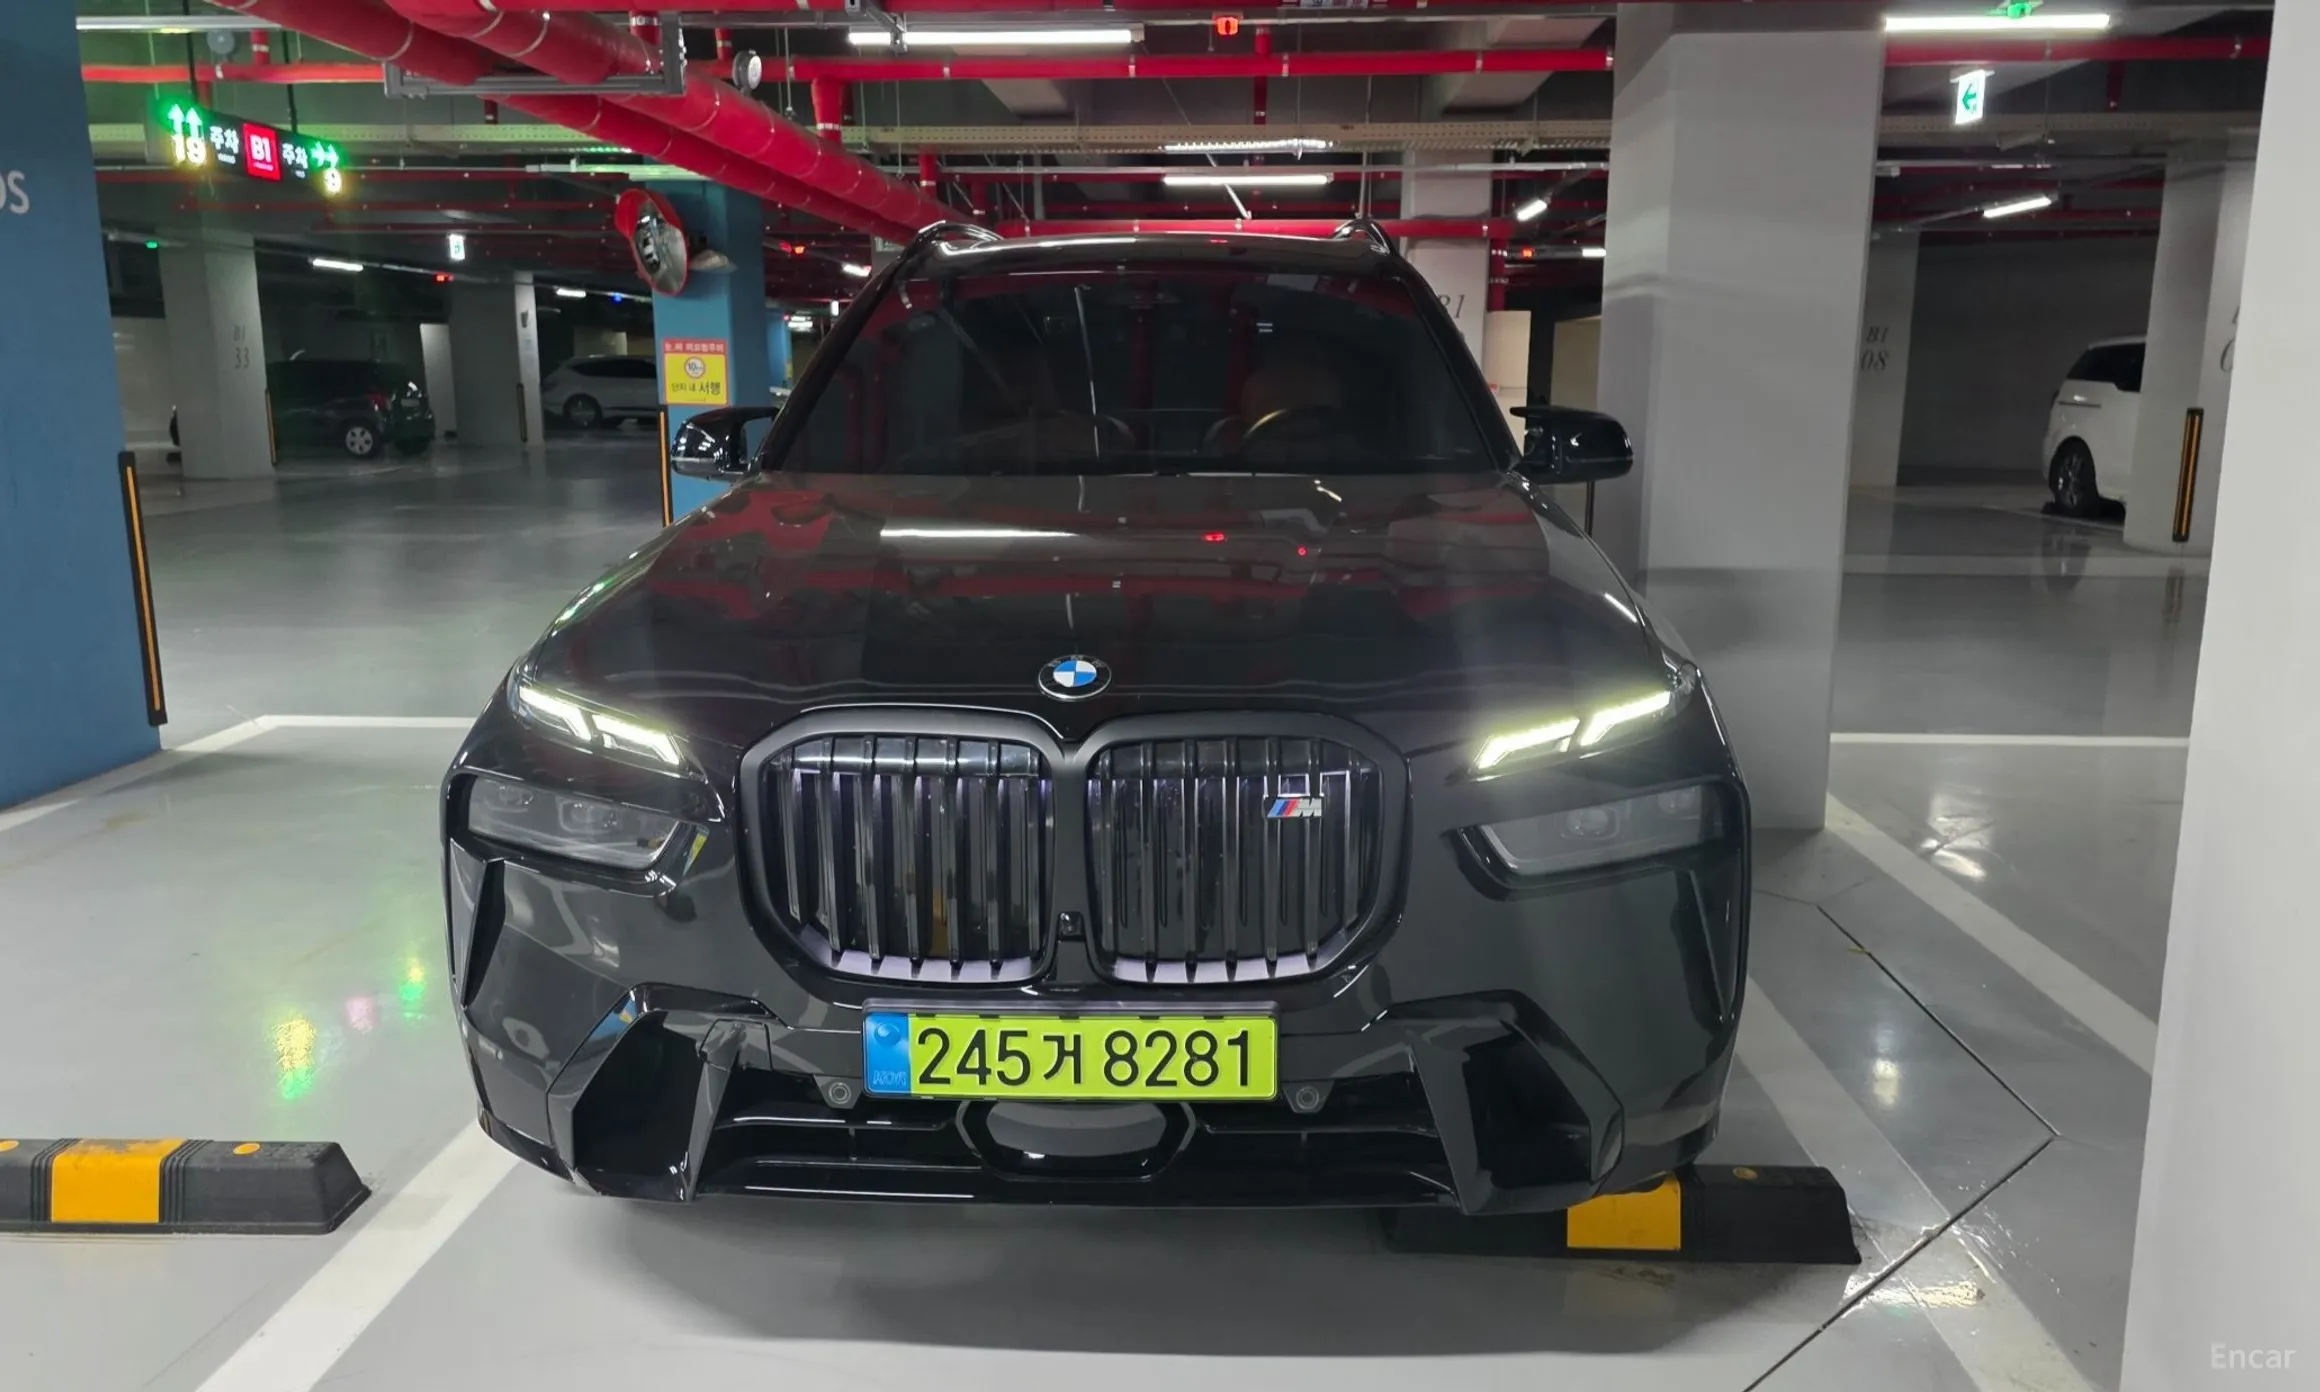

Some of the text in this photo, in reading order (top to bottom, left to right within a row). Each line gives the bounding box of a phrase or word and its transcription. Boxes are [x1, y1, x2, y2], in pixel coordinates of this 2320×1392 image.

[210, 126, 239, 154] 주차
[250, 135, 272, 162] B1
[282, 143, 308, 169] 주차
[917, 1027, 1250, 1088] 245거 8281
